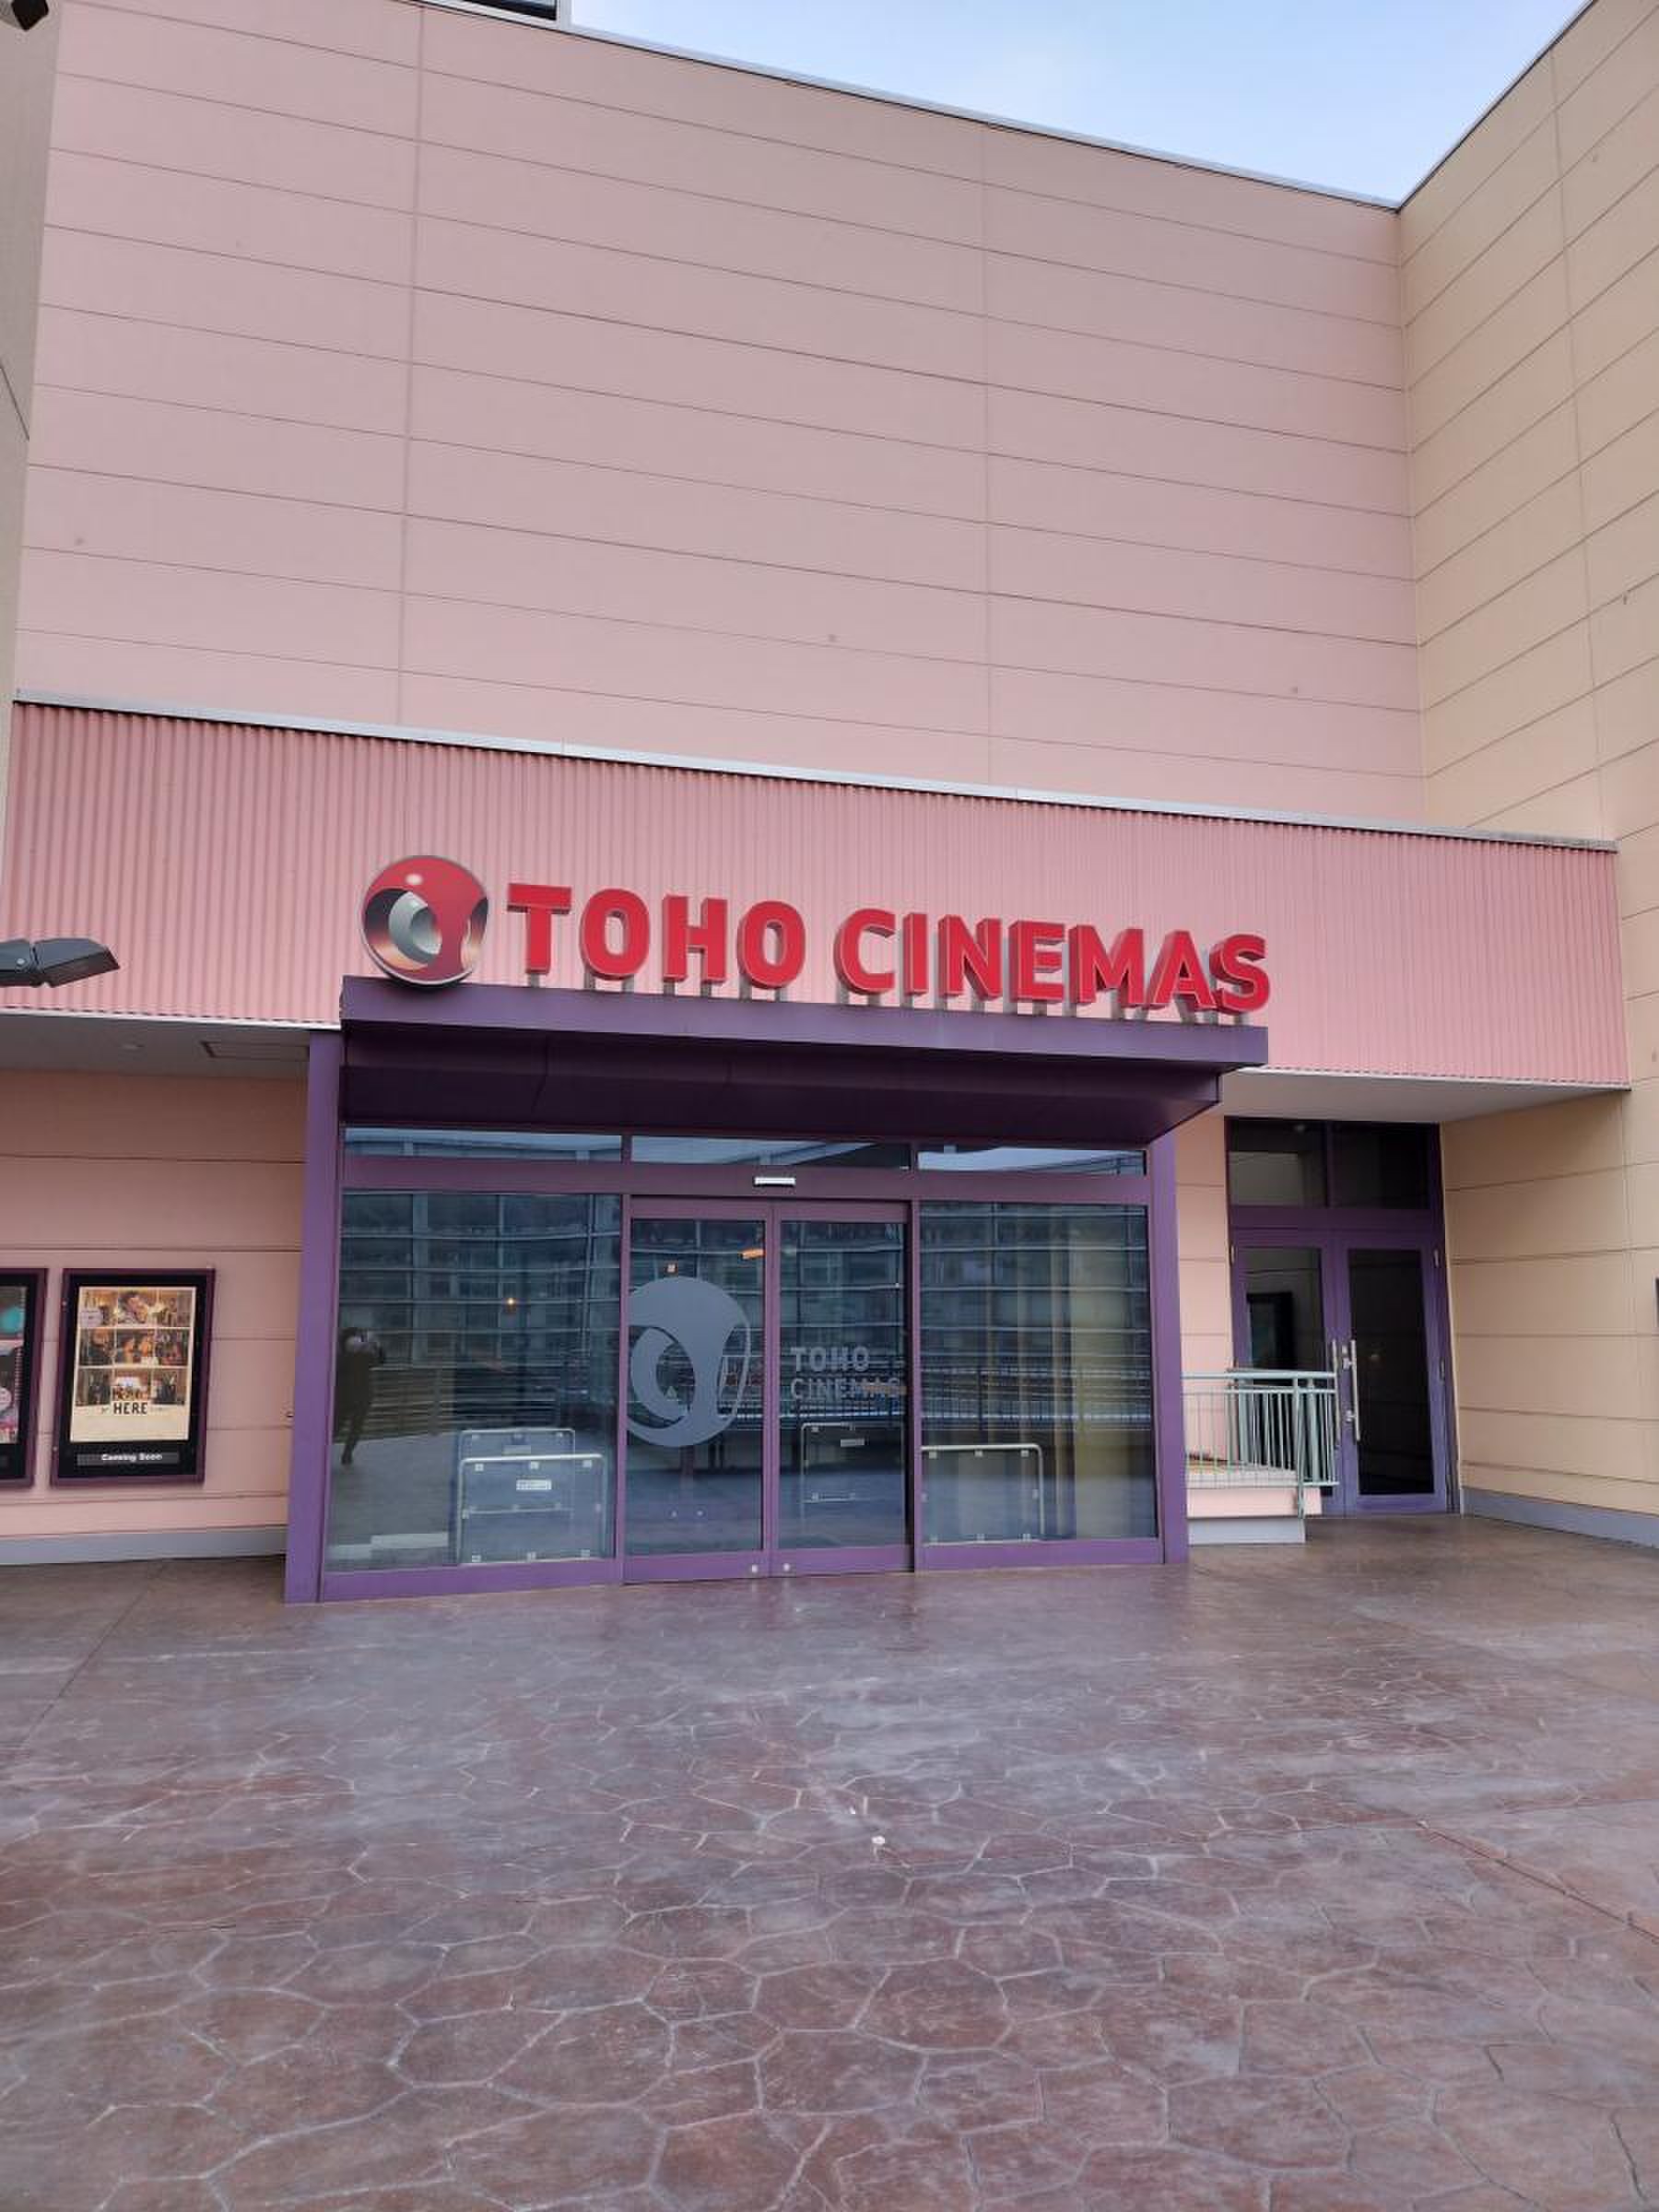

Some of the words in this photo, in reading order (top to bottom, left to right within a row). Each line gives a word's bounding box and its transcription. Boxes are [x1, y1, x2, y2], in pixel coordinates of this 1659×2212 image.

[507, 882, 806, 990] TOHO
[833, 908, 1271, 1013] CINEMAS
[790, 1346, 869, 1372] TOHO
[113, 1402, 147, 1415] HERE
